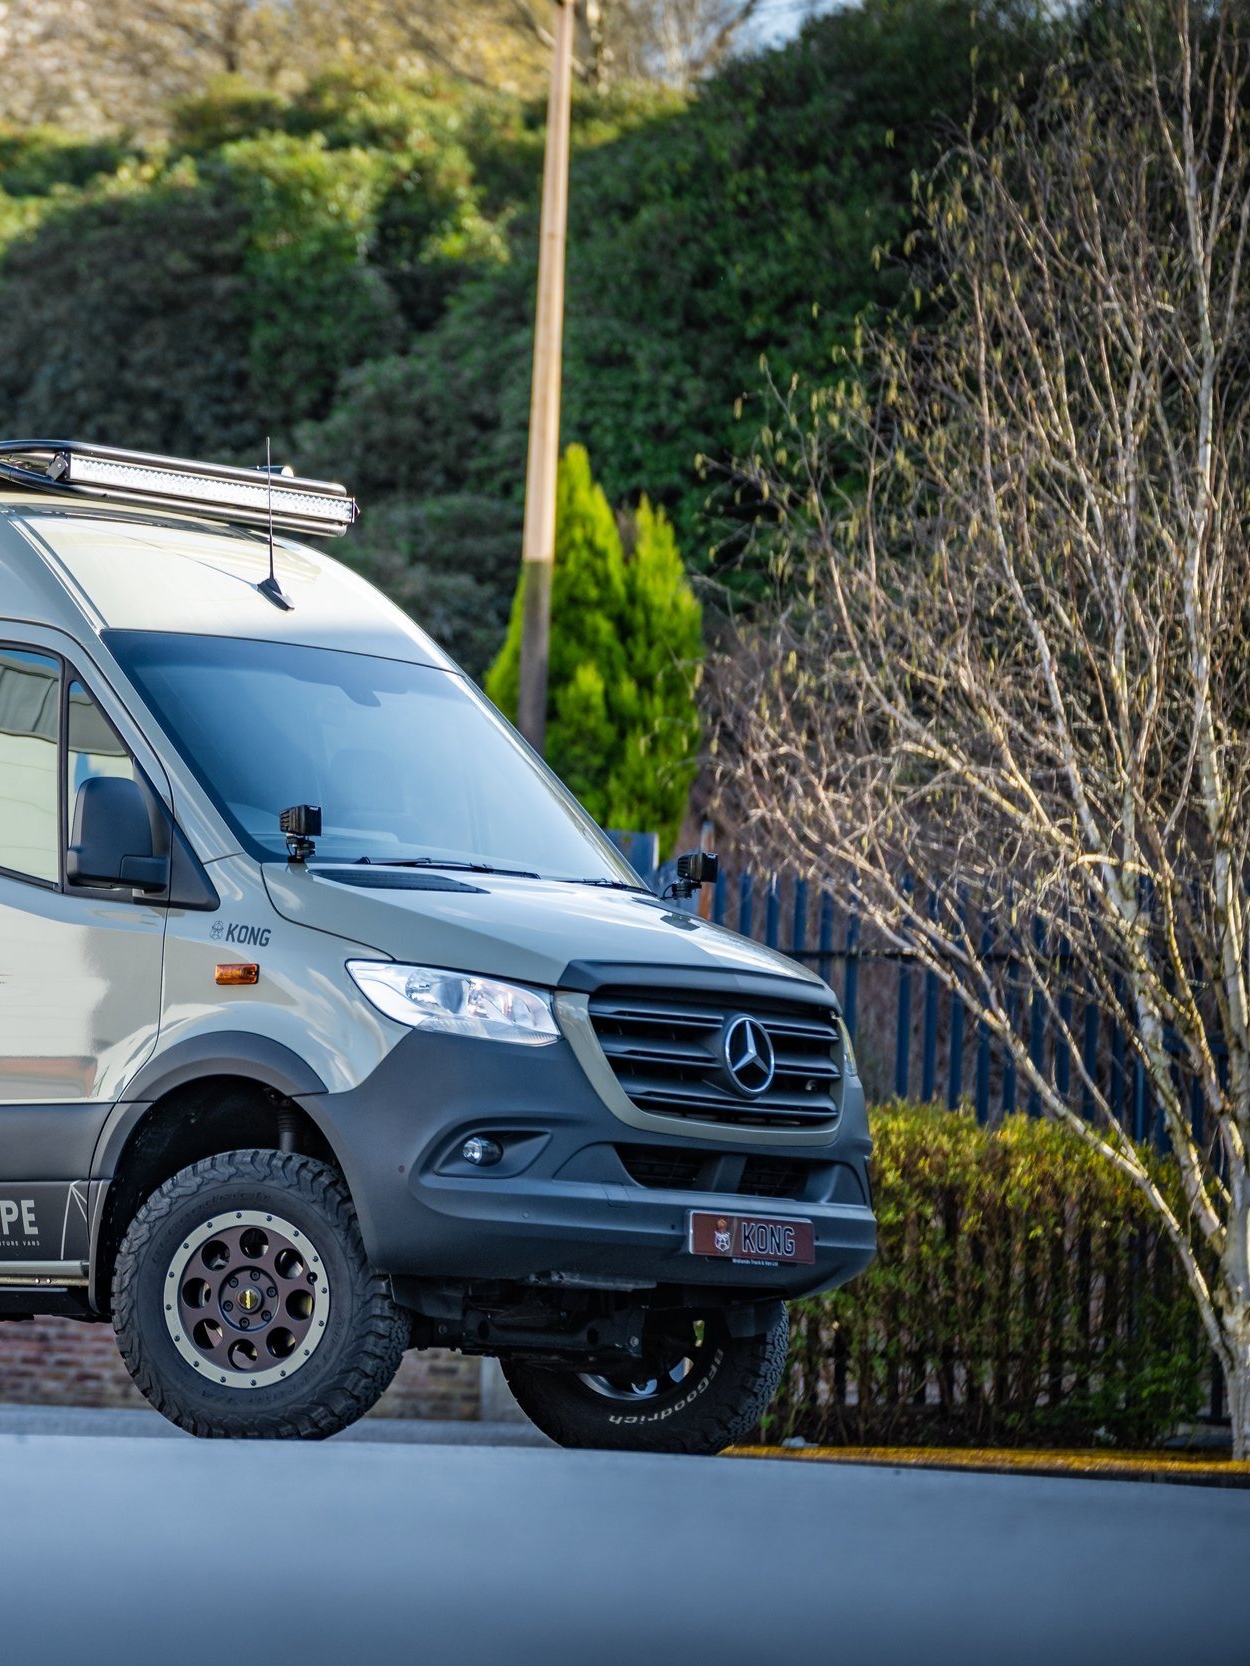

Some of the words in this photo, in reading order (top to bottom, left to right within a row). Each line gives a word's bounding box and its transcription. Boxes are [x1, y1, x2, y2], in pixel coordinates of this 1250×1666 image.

[225, 923, 272, 947] KONG
[741, 1222, 795, 1256] KONG
[608, 1347, 724, 1426] BFGoodrich
